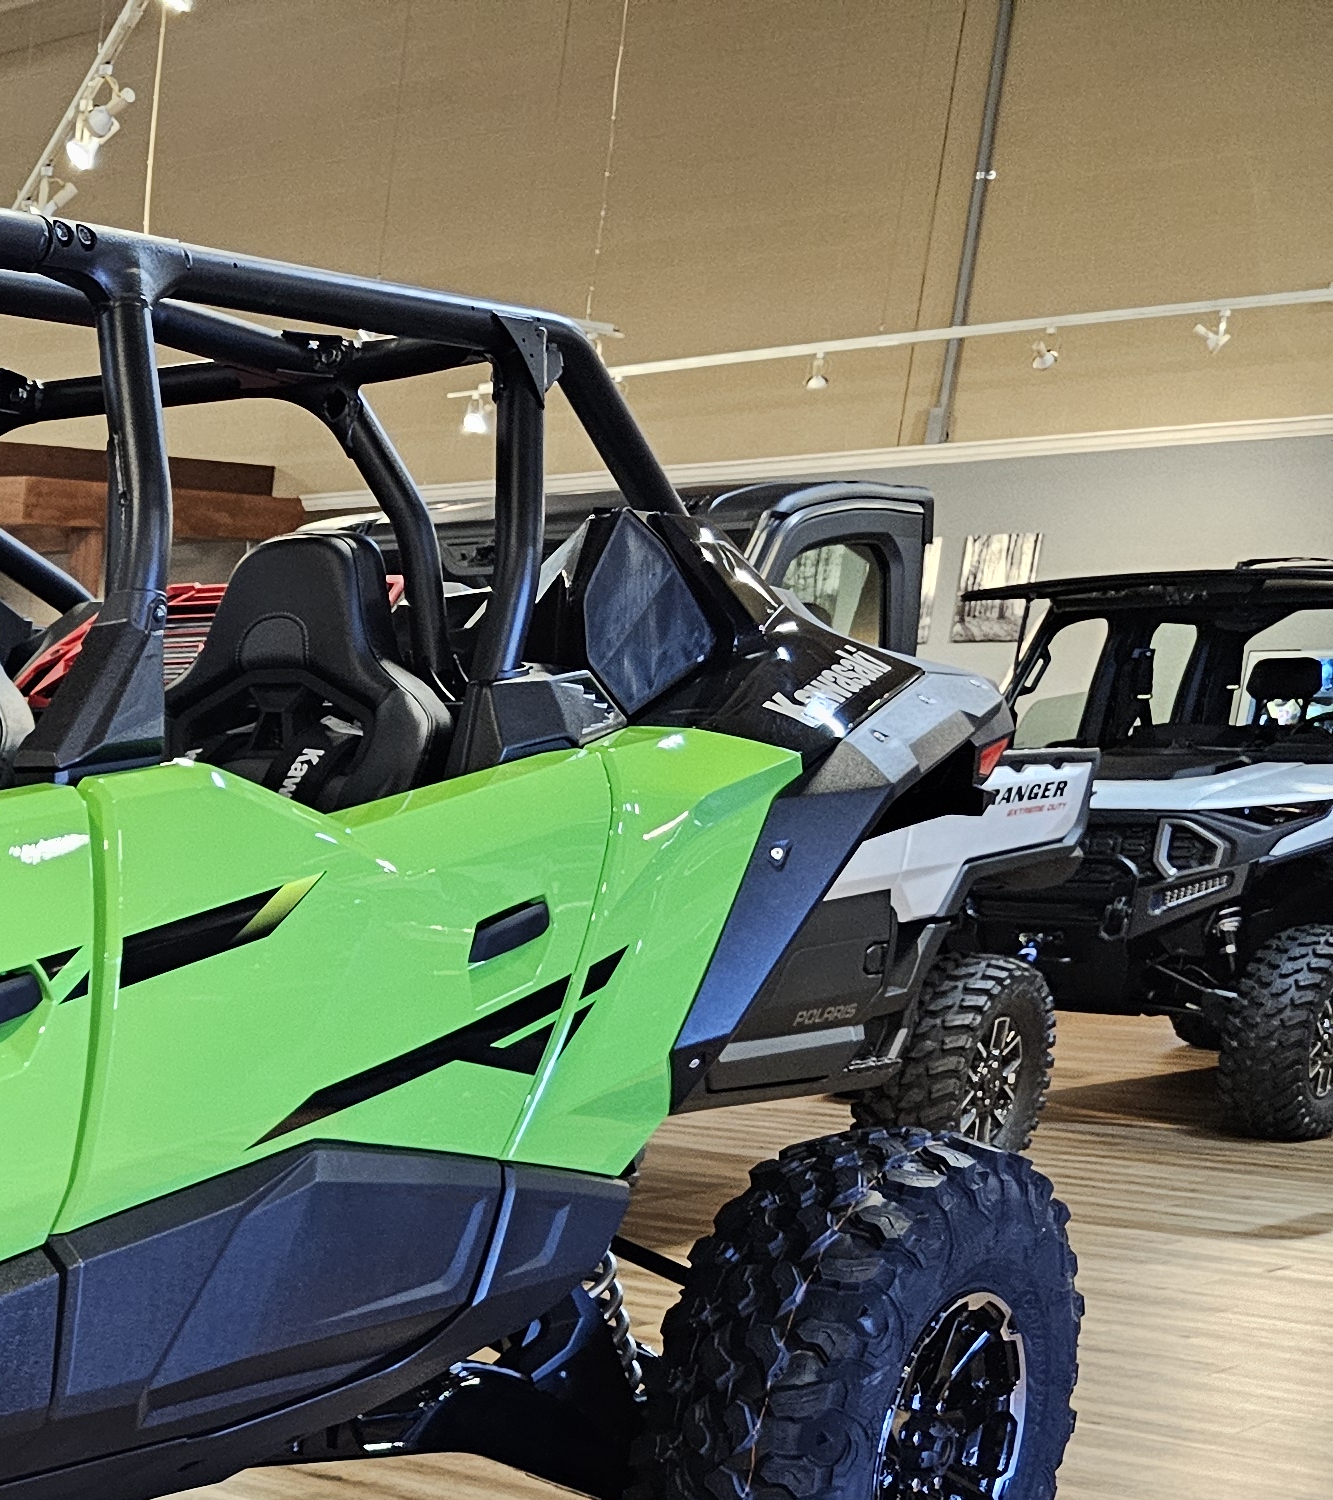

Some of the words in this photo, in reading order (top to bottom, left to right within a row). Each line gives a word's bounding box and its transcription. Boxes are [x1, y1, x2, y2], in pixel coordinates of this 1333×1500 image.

[1007, 805, 1045, 817] EXTREME
[1047, 802, 1068, 812] DUTY
[793, 1003, 858, 1027] POLARIS
